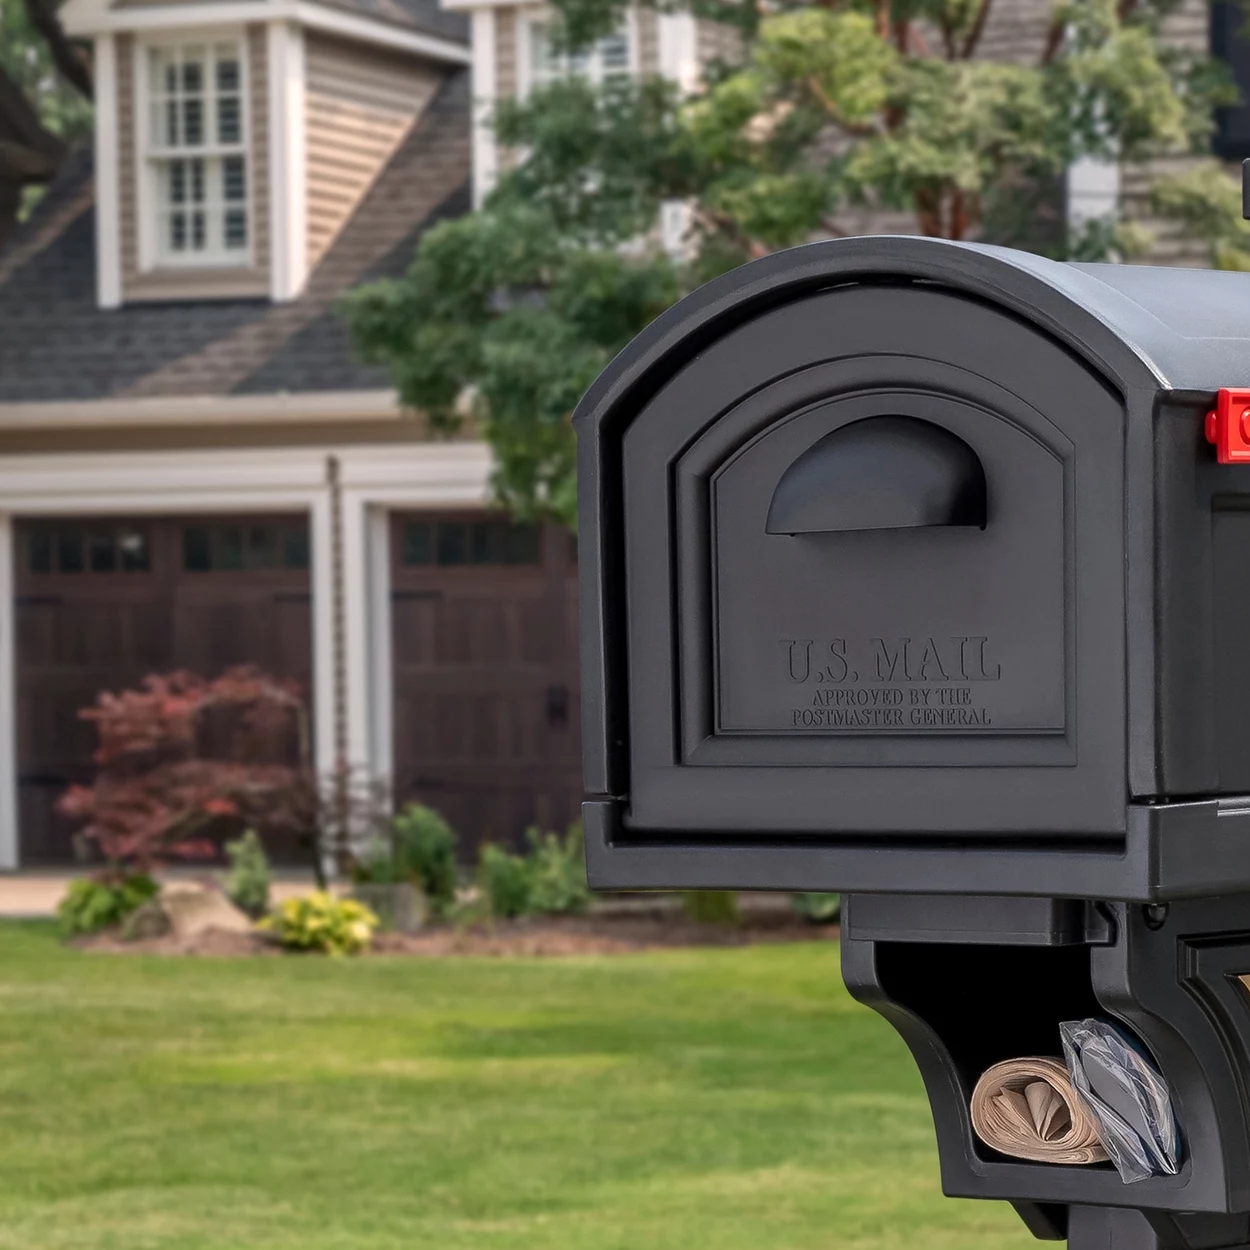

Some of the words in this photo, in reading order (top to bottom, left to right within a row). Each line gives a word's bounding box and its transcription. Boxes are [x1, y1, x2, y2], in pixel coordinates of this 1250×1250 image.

[779, 638, 860, 683] U.S.
[870, 636, 1001, 682] MAIL
[812, 688, 904, 706] APPROVED
[908, 687, 933, 706] BY
[934, 687, 972, 706] THE
[791, 708, 904, 727] POSTMASTER
[909, 708, 992, 726] GENERAL
